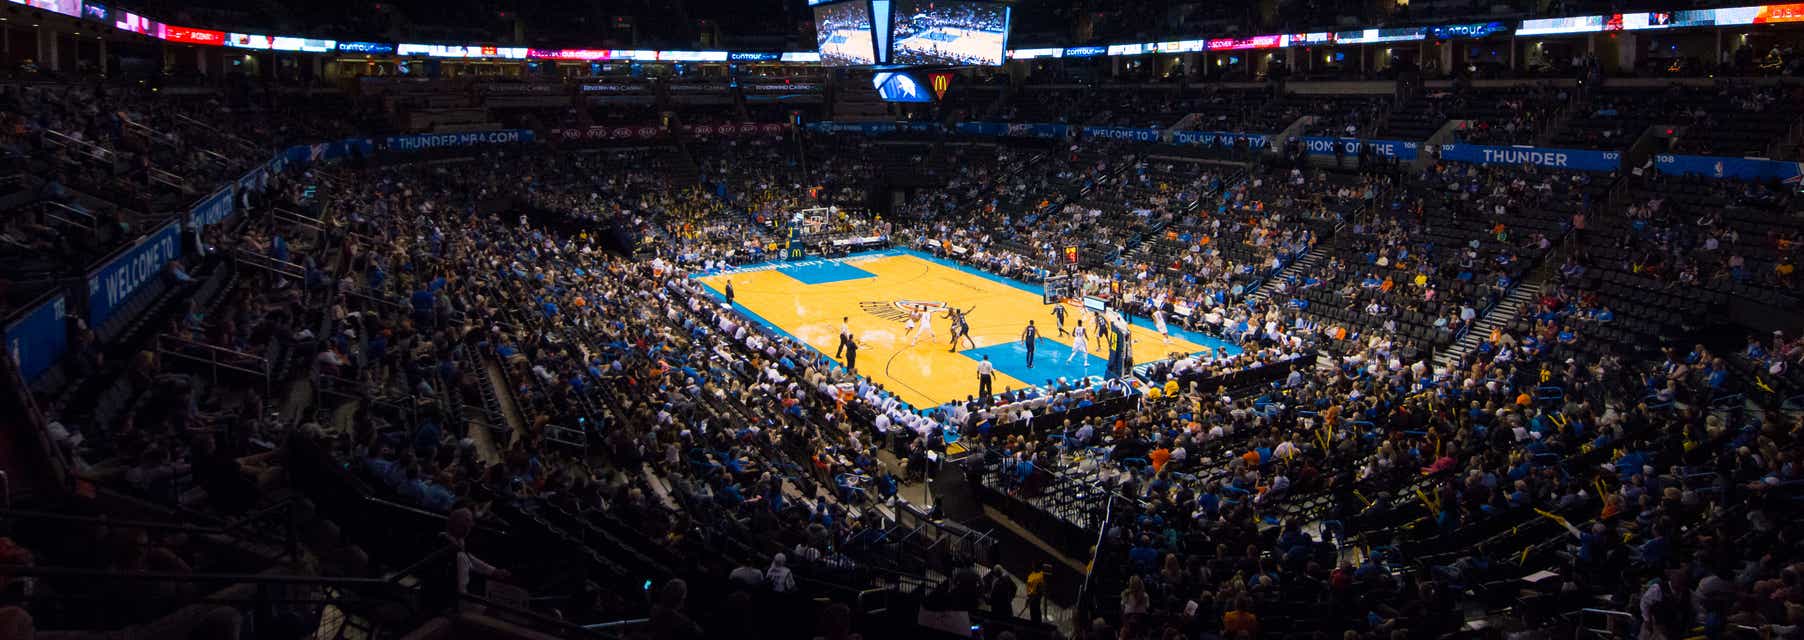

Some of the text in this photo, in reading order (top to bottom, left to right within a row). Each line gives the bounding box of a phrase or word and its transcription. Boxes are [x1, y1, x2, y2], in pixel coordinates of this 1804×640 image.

[1306, 139, 1340, 152] HOM
[1483, 149, 1568, 167] THUNDER
[1602, 152, 1618, 160] 107
[1656, 154, 1675, 164] 108
[105, 242, 161, 308] WELCOME
